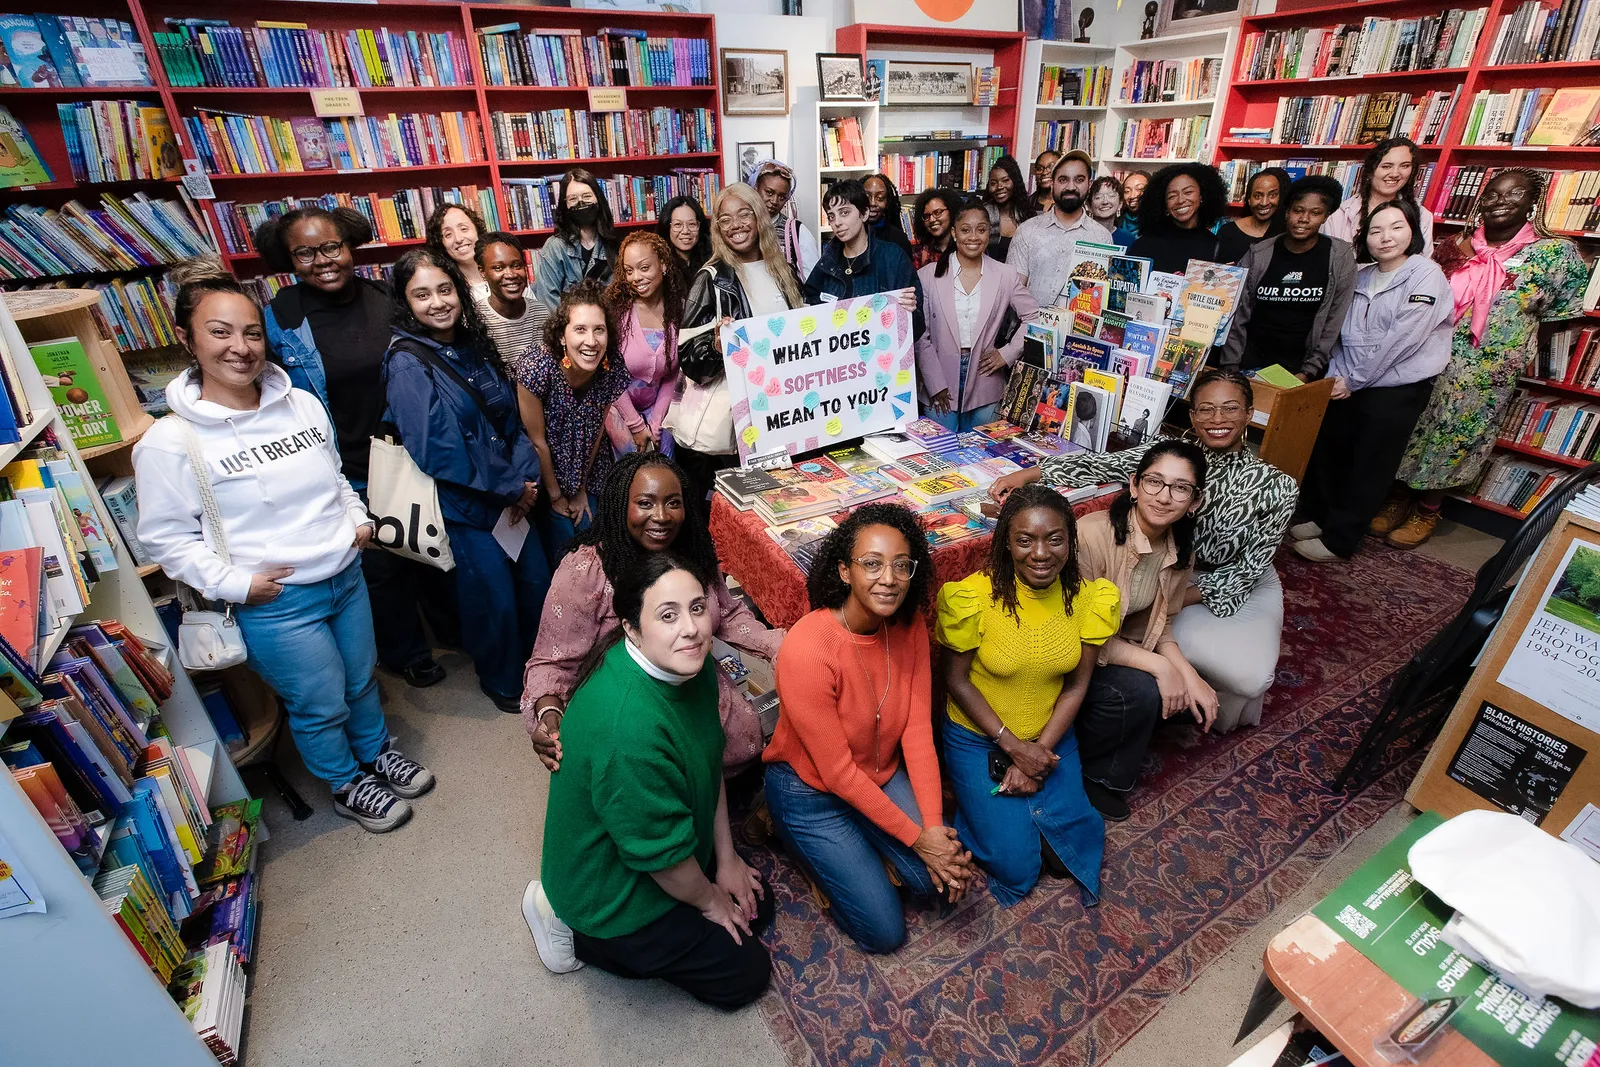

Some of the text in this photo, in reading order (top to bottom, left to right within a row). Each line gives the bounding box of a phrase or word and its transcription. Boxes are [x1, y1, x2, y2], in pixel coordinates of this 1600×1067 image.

[1369, 100, 1397, 113] BLACK AF
[1366, 112, 1394, 124] HISTORY
[1109, 279, 1138, 293] LEOPATRA
[1257, 286, 1323, 297] OUR ROOTS
[1077, 293, 1092, 303] LEAVE
[1187, 292, 1225, 307] TURTLE ISLAND
[1077, 301, 1092, 311] YOUR
[1039, 311, 1053, 320] PICK
[1127, 331, 1148, 341] WINTER
[46, 349, 70, 358] JONATHAN
[772, 329, 871, 366] WHAT DOES
[1164, 342, 1190, 354] LEGACY
[51, 355, 70, 363] WILSON
[1114, 357, 1132, 367] BLACKNESS
[1112, 362, 1122, 373] IS
[784, 361, 868, 395] SOFTNESS
[1130, 383, 1154, 395] LORRAINE
[56, 399, 103, 418] POWER
[765, 386, 889, 432] MEAN TO YOU?
[67, 420, 109, 439] GLORY
[219, 426, 326, 475] JUST BREATHE
[107, 497, 118, 510] WHO
[117, 514, 127, 525] ARE
[1536, 617, 1570, 636] JEFF
[1530, 628, 1600, 666] PHOTOG
[1482, 713, 1565, 760] Wikipedia Edit-A-Thon
[1484, 706, 1569, 754] BLACK HISTORIES
[1419, 921, 1431, 930] MON
[1410, 928, 1423, 941] JULY
[1412, 926, 1442, 957] SKÁLD
[1444, 952, 1457, 966] JUNE
[1436, 956, 1473, 993] MIRLOS
[1491, 988, 1530, 1025] ELEIGH
[1504, 1017, 1521, 1036] AND
[1517, 1000, 1562, 1049] SHAKURA
